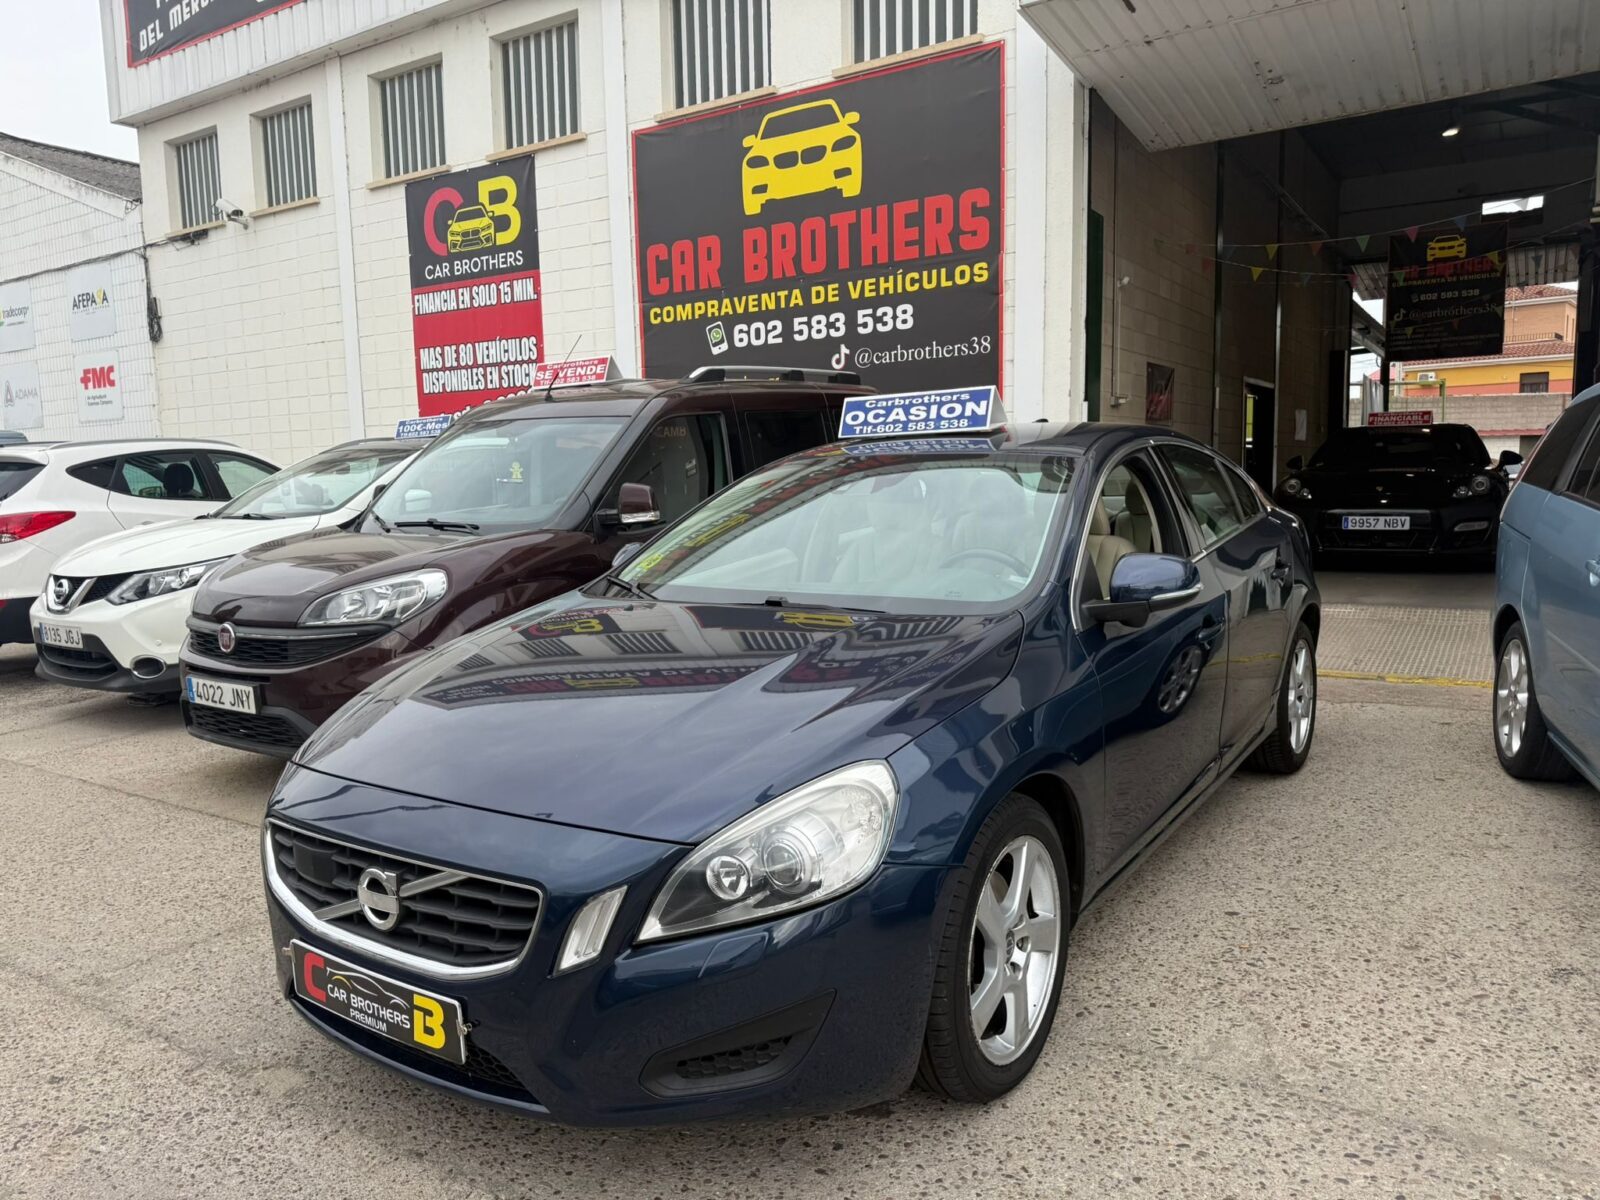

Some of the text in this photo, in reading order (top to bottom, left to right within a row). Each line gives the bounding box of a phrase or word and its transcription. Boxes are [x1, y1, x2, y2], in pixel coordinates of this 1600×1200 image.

[139, 19, 164, 52] DEL
[646, 187, 990, 297] CAR BROTHERS
[425, 249, 524, 280] CAR BROTHERS
[414, 278, 537, 316] FINANCIA EN SOLO 15 MIN.
[649, 261, 990, 325] COMPRAVENTA DE VEHÍCULOS
[733, 303, 914, 349] 602 583 538
[420, 336, 537, 370] MAS DE 80 VEHÍCULOS
[855, 335, 991, 368] @carbrothers38
[81, 365, 115, 390] FMC
[422, 362, 537, 394] DISPONIBLES EN STOCK
[536, 364, 606, 380] SE VENDE
[845, 400, 988, 425] OCASION
[865, 392, 971, 408] Carbrothers
[853, 419, 969, 435] Tlf-602 583 538
[1350, 517, 1407, 529] 9957 NBV
[64, 629, 81, 645] JGJ
[197, 681, 251, 710] 4022 JNY
[327, 983, 411, 1030] CAR BROTHERS
[350, 1008, 388, 1033] PREMIUM
